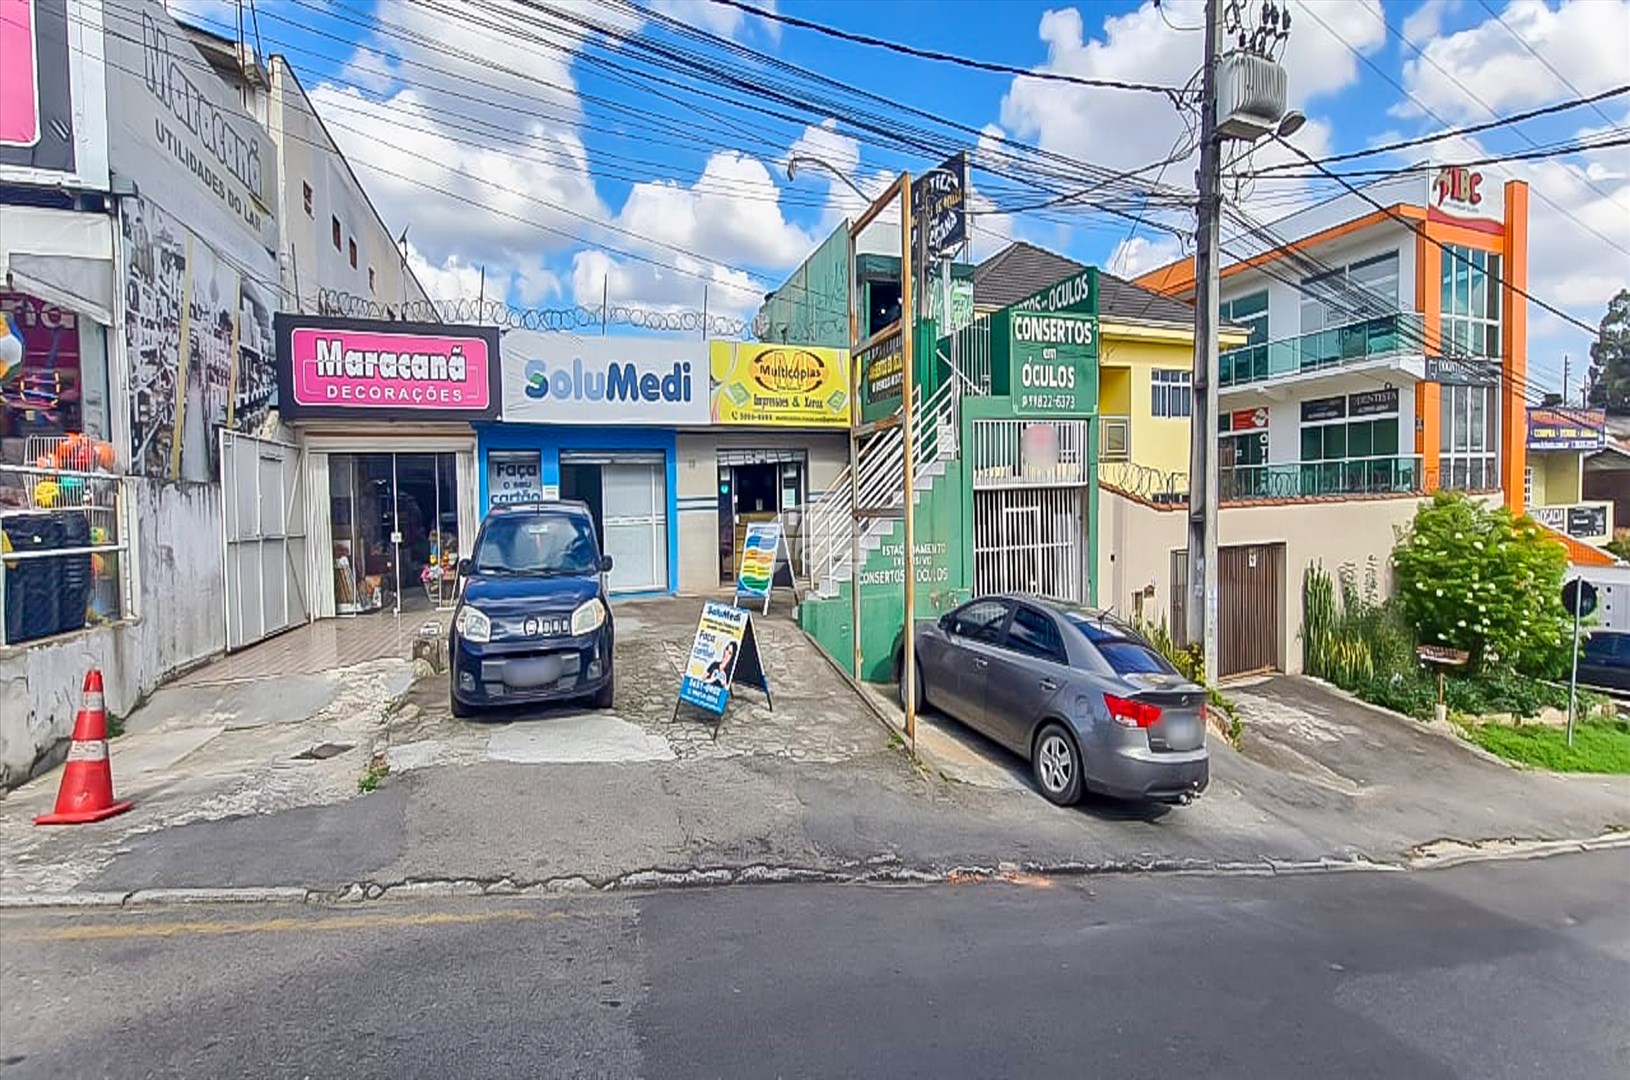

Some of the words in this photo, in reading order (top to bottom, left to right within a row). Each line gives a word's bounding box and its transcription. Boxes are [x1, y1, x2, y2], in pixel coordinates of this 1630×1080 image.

[155, 119, 225, 198] UTILIDADES
[228, 189, 242, 213] DO
[243, 206, 261, 232] LAR
[1014, 316, 1092, 344] CONSERTOS
[316, 339, 466, 381] Maracanã
[1042, 348, 1057, 360] em
[525, 358, 691, 402] SoluMedi
[1022, 357, 1075, 389] ÓCULOS
[327, 385, 462, 403] DECORAÇÕES
[497, 462, 537, 479] Faça
[513, 481, 532, 489] seu
